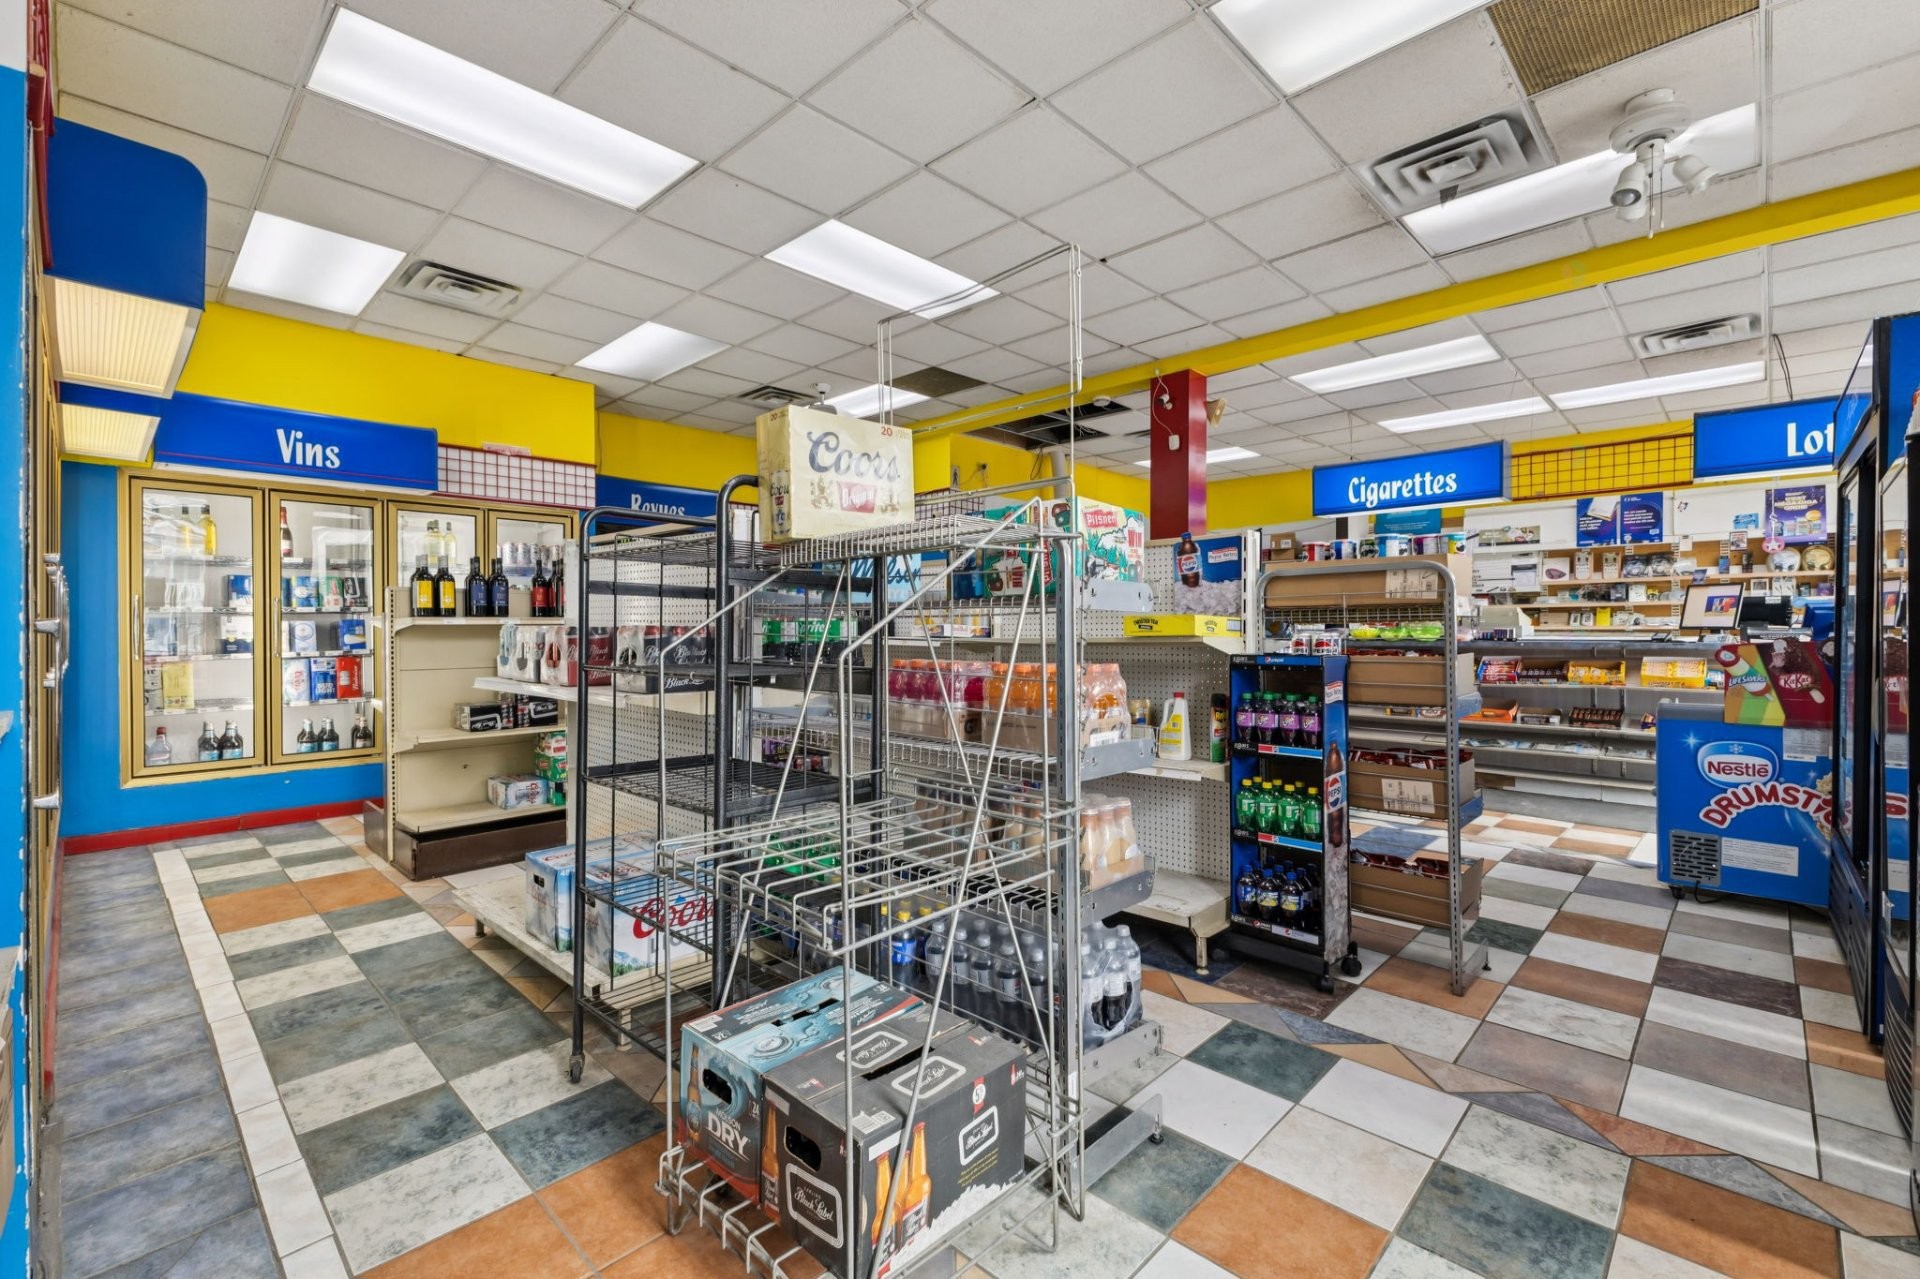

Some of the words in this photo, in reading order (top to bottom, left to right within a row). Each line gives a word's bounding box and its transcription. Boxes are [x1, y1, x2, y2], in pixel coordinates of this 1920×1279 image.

[276, 428, 341, 469] Vins
[881, 426, 893, 437] 20
[806, 431, 900, 482] Coors
[1348, 471, 1457, 508] Cigarettes
[1086, 513, 1117, 527] Pilsner
[1128, 530, 1142, 548] WIN
[1328, 787, 1341, 798] PEPSI
[632, 896, 714, 939] Coor
[752, 1101, 760, 1116] 24
[707, 1111, 749, 1156] DRY
[795, 1187, 814, 1210] Black
[814, 1199, 834, 1221] Label
